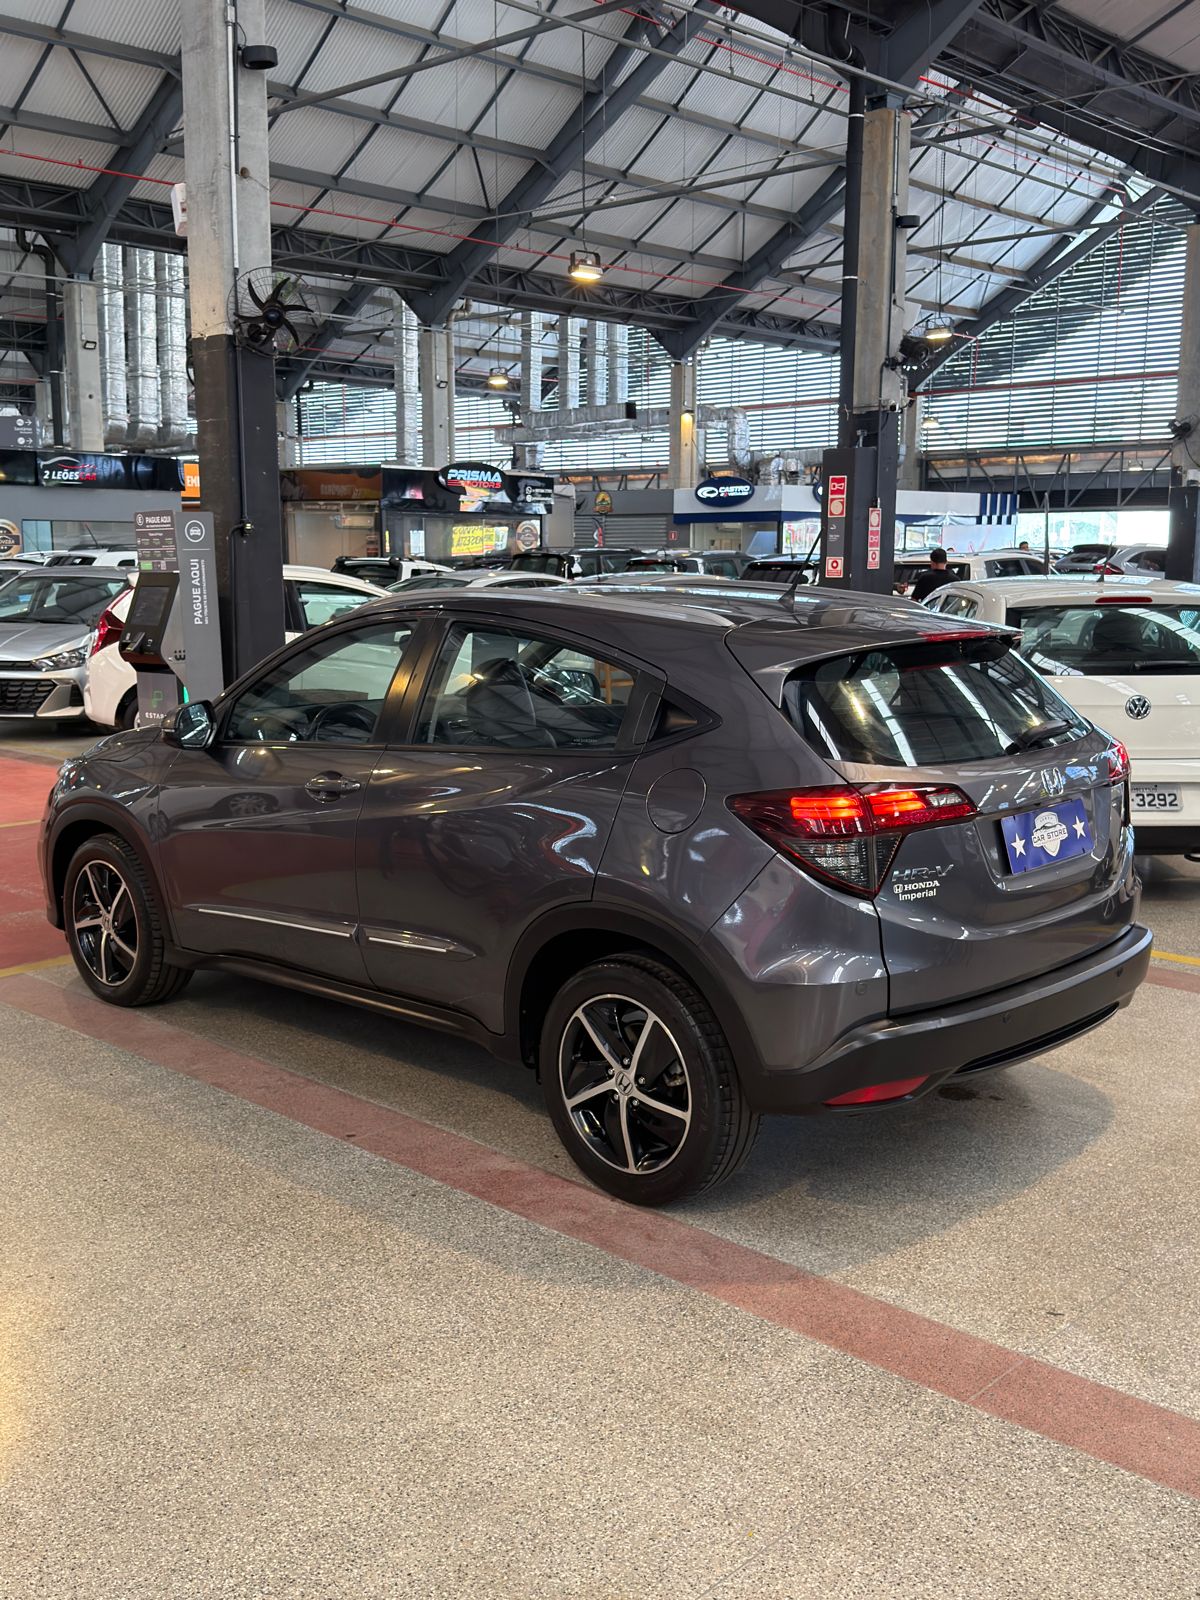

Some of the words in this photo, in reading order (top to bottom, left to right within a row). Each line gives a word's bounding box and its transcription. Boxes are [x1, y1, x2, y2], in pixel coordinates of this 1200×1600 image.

[43, 470, 50, 479] 2
[448, 469, 502, 482] PRISMA
[719, 485, 750, 493] CASTRO
[190, 559, 200, 586] AQUI
[192, 588, 203, 625] PAGUE
[1033, 835, 1045, 844] CAR
[1047, 827, 1067, 840] STORE
[892, 864, 954, 881] HR-V
[904, 880, 941, 891] HONDA
[899, 888, 937, 901] Imperial
